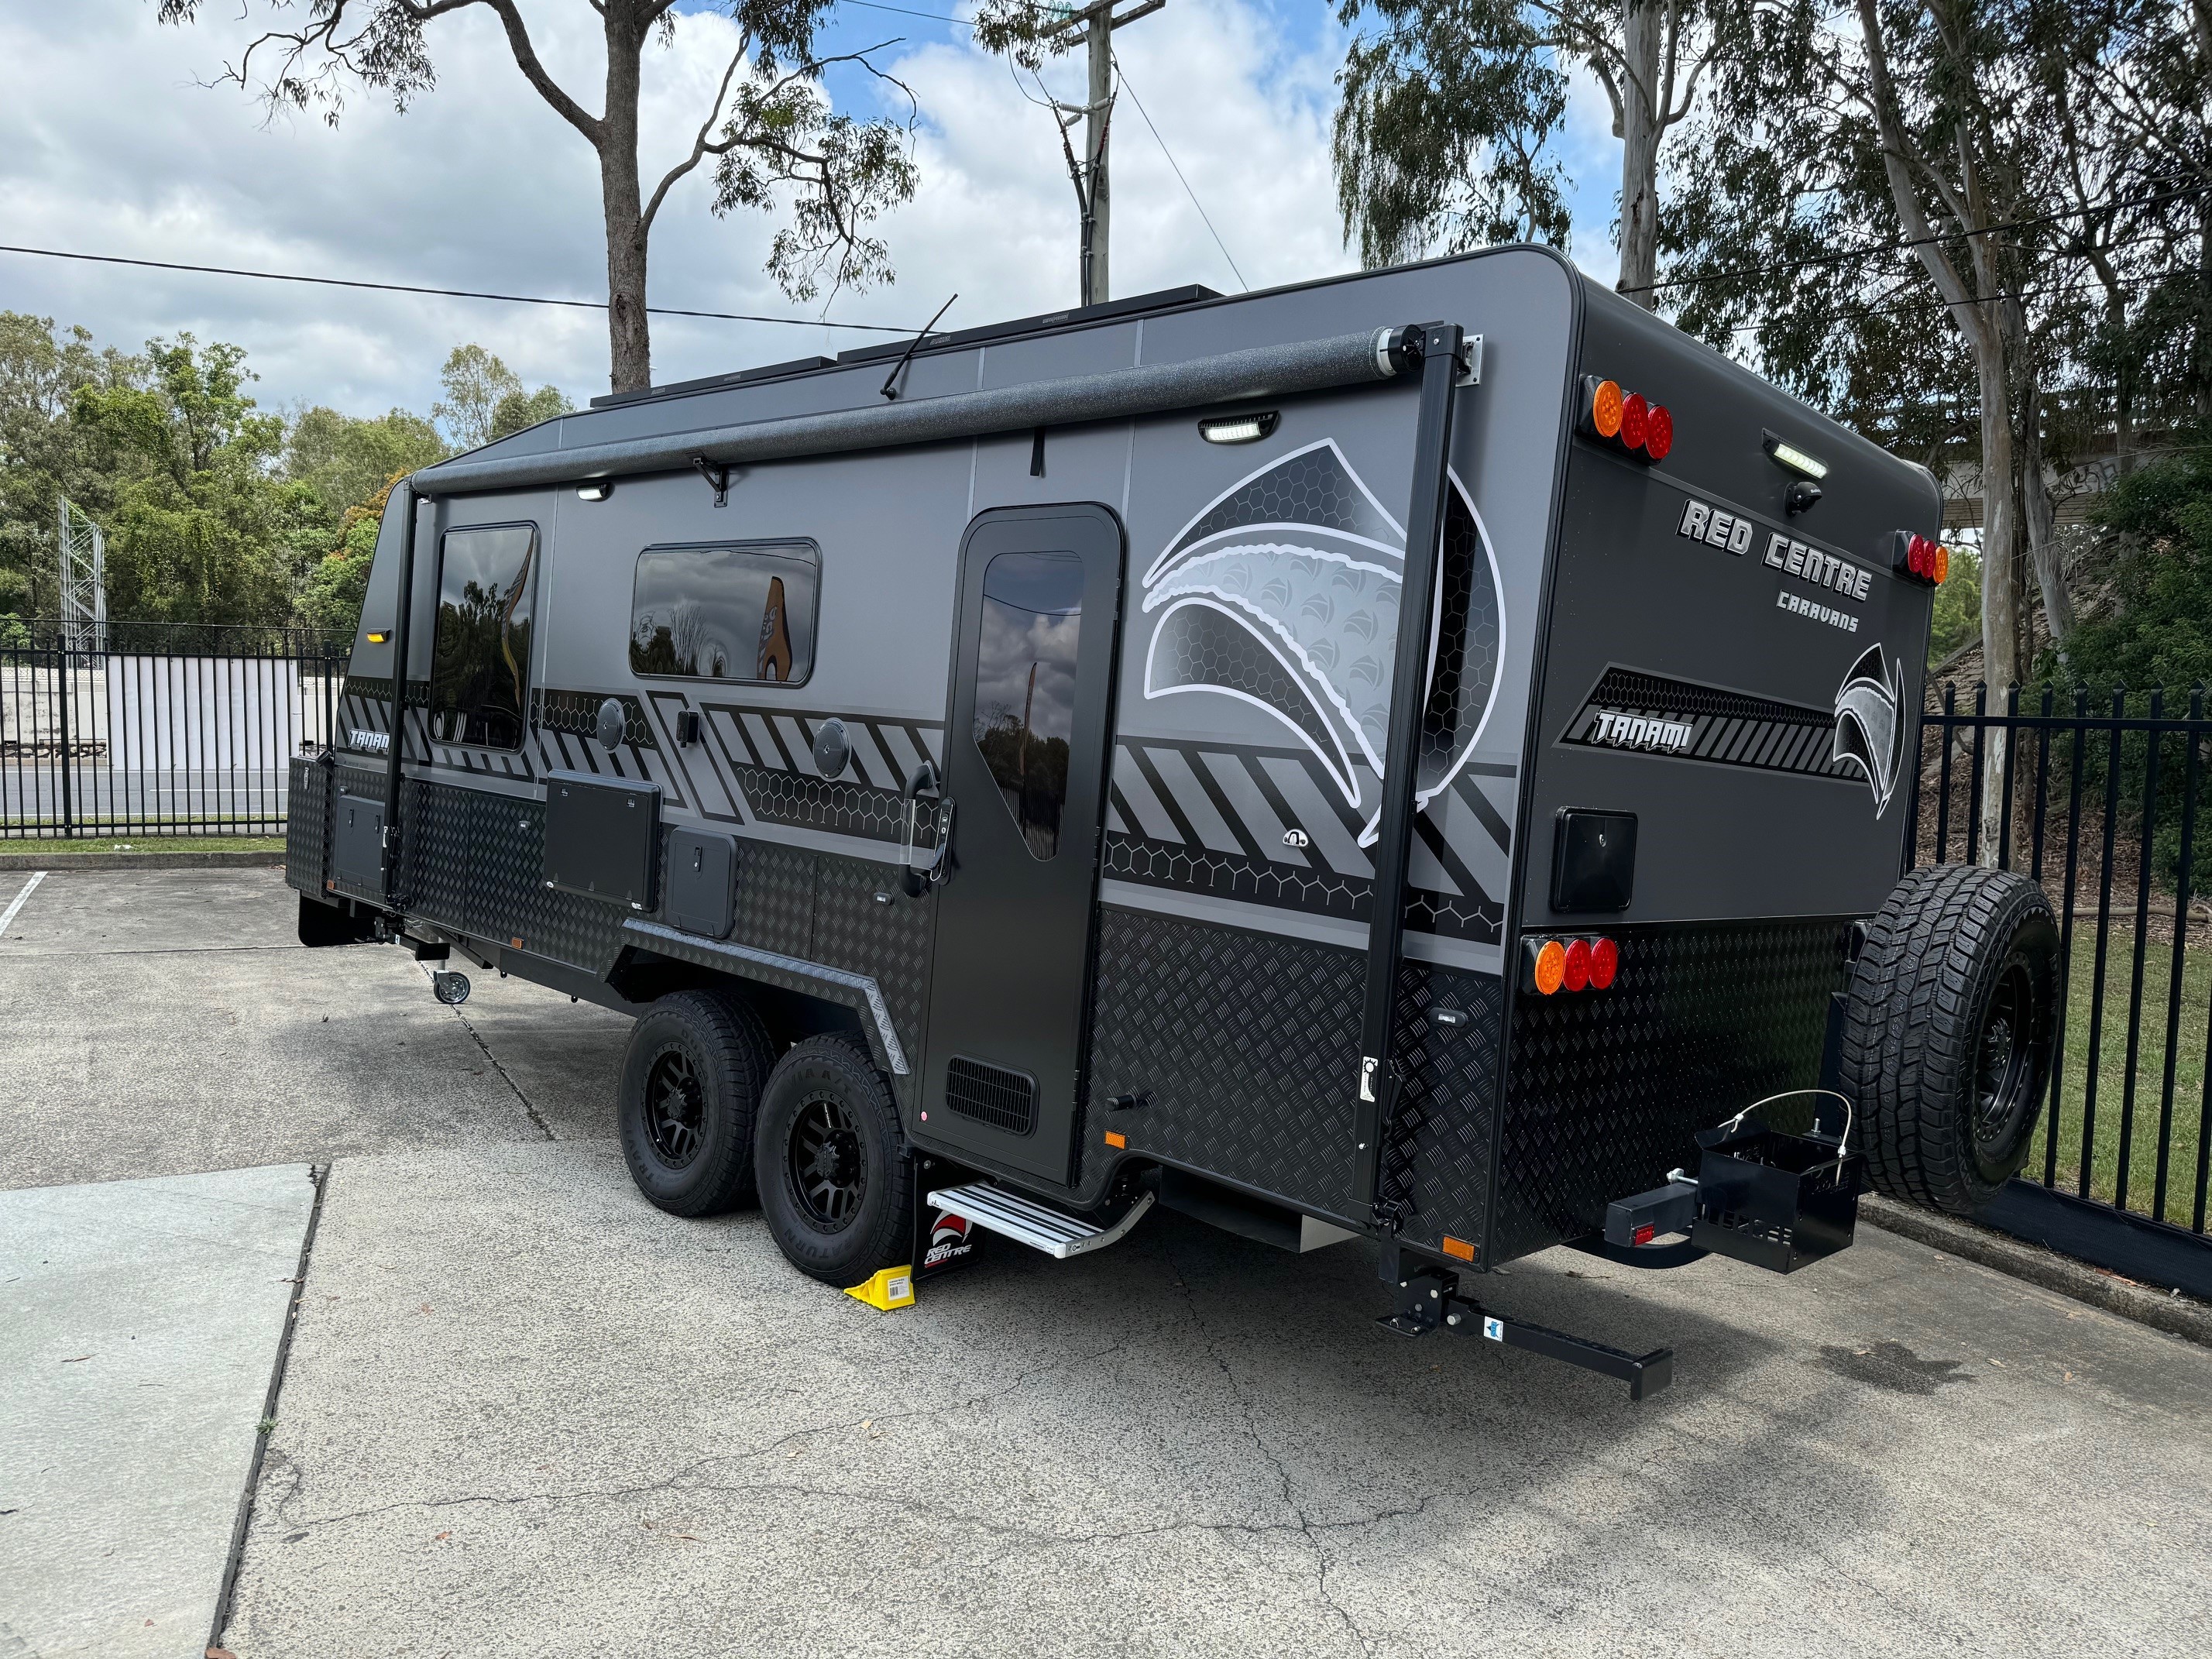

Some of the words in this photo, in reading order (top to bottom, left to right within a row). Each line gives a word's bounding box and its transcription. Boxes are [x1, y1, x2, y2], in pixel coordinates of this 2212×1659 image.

[1676, 499, 1753, 555] RED
[1761, 532, 1872, 601] CENTRE
[1777, 589, 1859, 633] CARAVANS
[1592, 710, 1693, 753] TANAMI
[924, 1244, 972, 1265] CENTRE
[926, 1242, 951, 1257] RED
